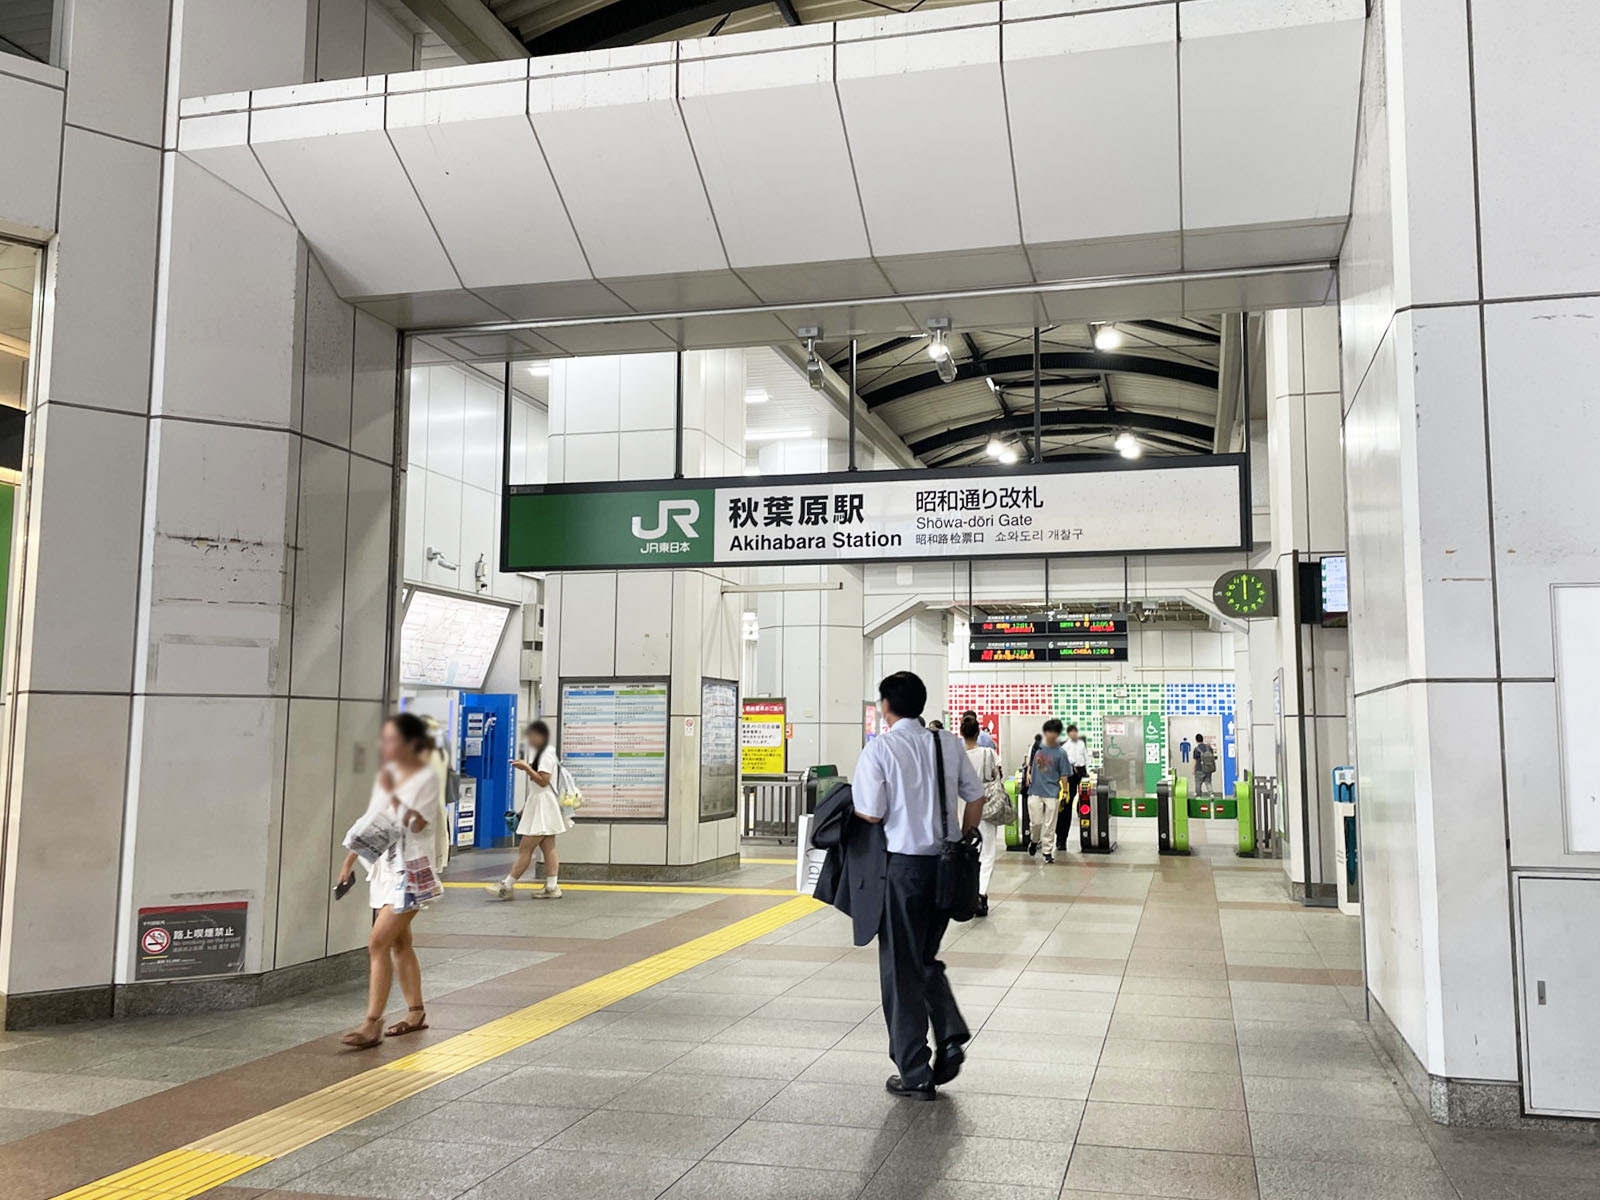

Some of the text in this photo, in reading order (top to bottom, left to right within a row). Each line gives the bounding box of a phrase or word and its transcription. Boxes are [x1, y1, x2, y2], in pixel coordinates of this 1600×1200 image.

[915, 486, 1044, 512] 昭和通り改札
[631, 499, 700, 540] JR
[729, 494, 864, 528] 秋葉原駅
[998, 513, 1033, 527] Gate
[729, 530, 902, 552] Akihabara Station
[915, 528, 1085, 545] 昭和路检票口 쇼와도리 개찰구
[640, 541, 691, 554] JR東日本
[173, 927, 235, 940] 路上喫煙禁止
